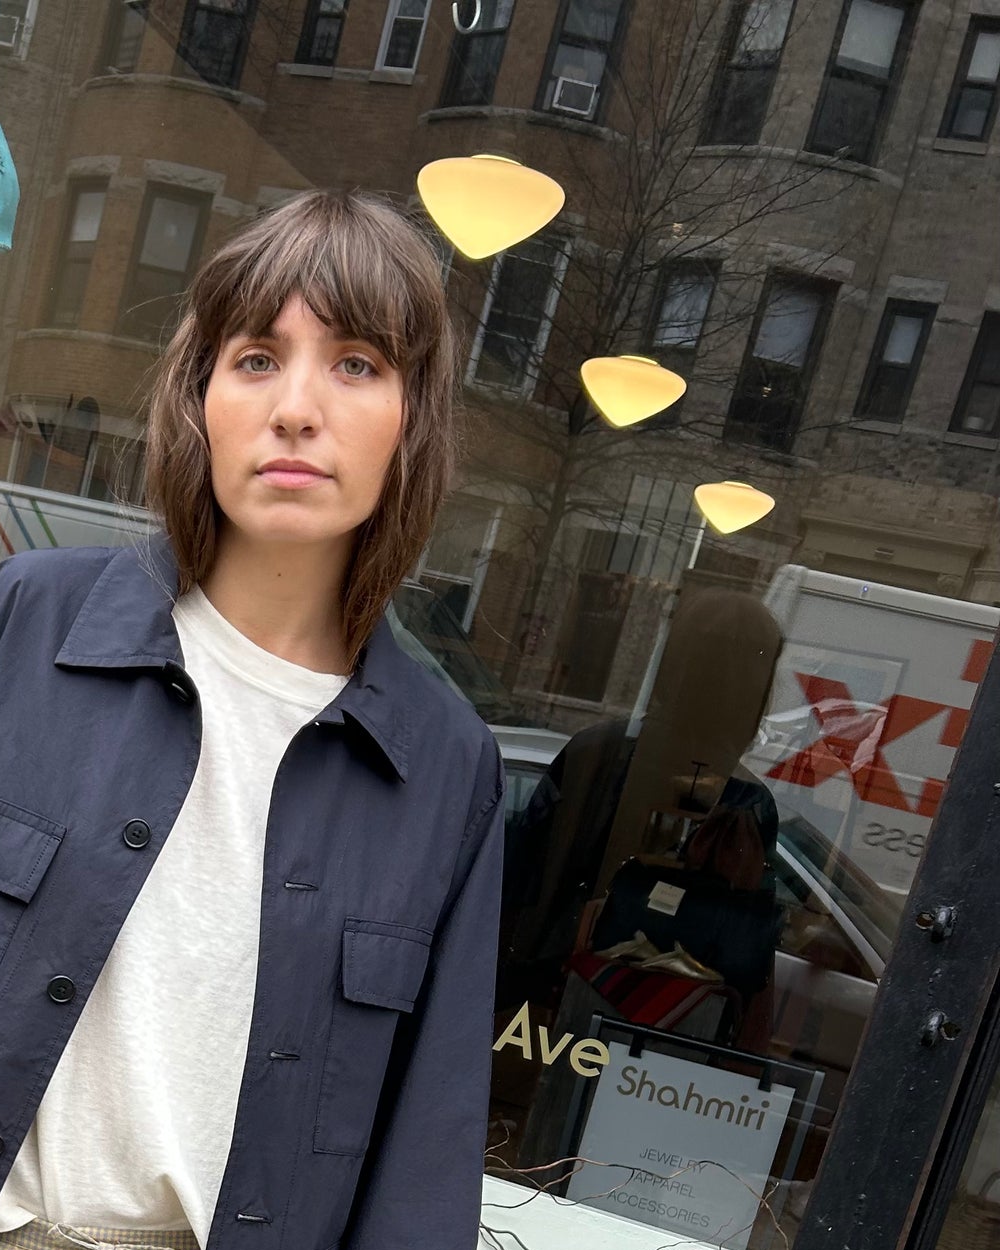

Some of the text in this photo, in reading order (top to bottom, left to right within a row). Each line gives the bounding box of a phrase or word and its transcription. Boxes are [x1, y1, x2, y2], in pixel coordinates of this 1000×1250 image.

[492, 1000, 611, 1077] Ave
[616, 1065, 771, 1131] Shahmiri
[639, 1148, 708, 1174] JEWELRY
[633, 1171, 696, 1199] APPAREL
[607, 1190, 711, 1228] ACCESSORIES
